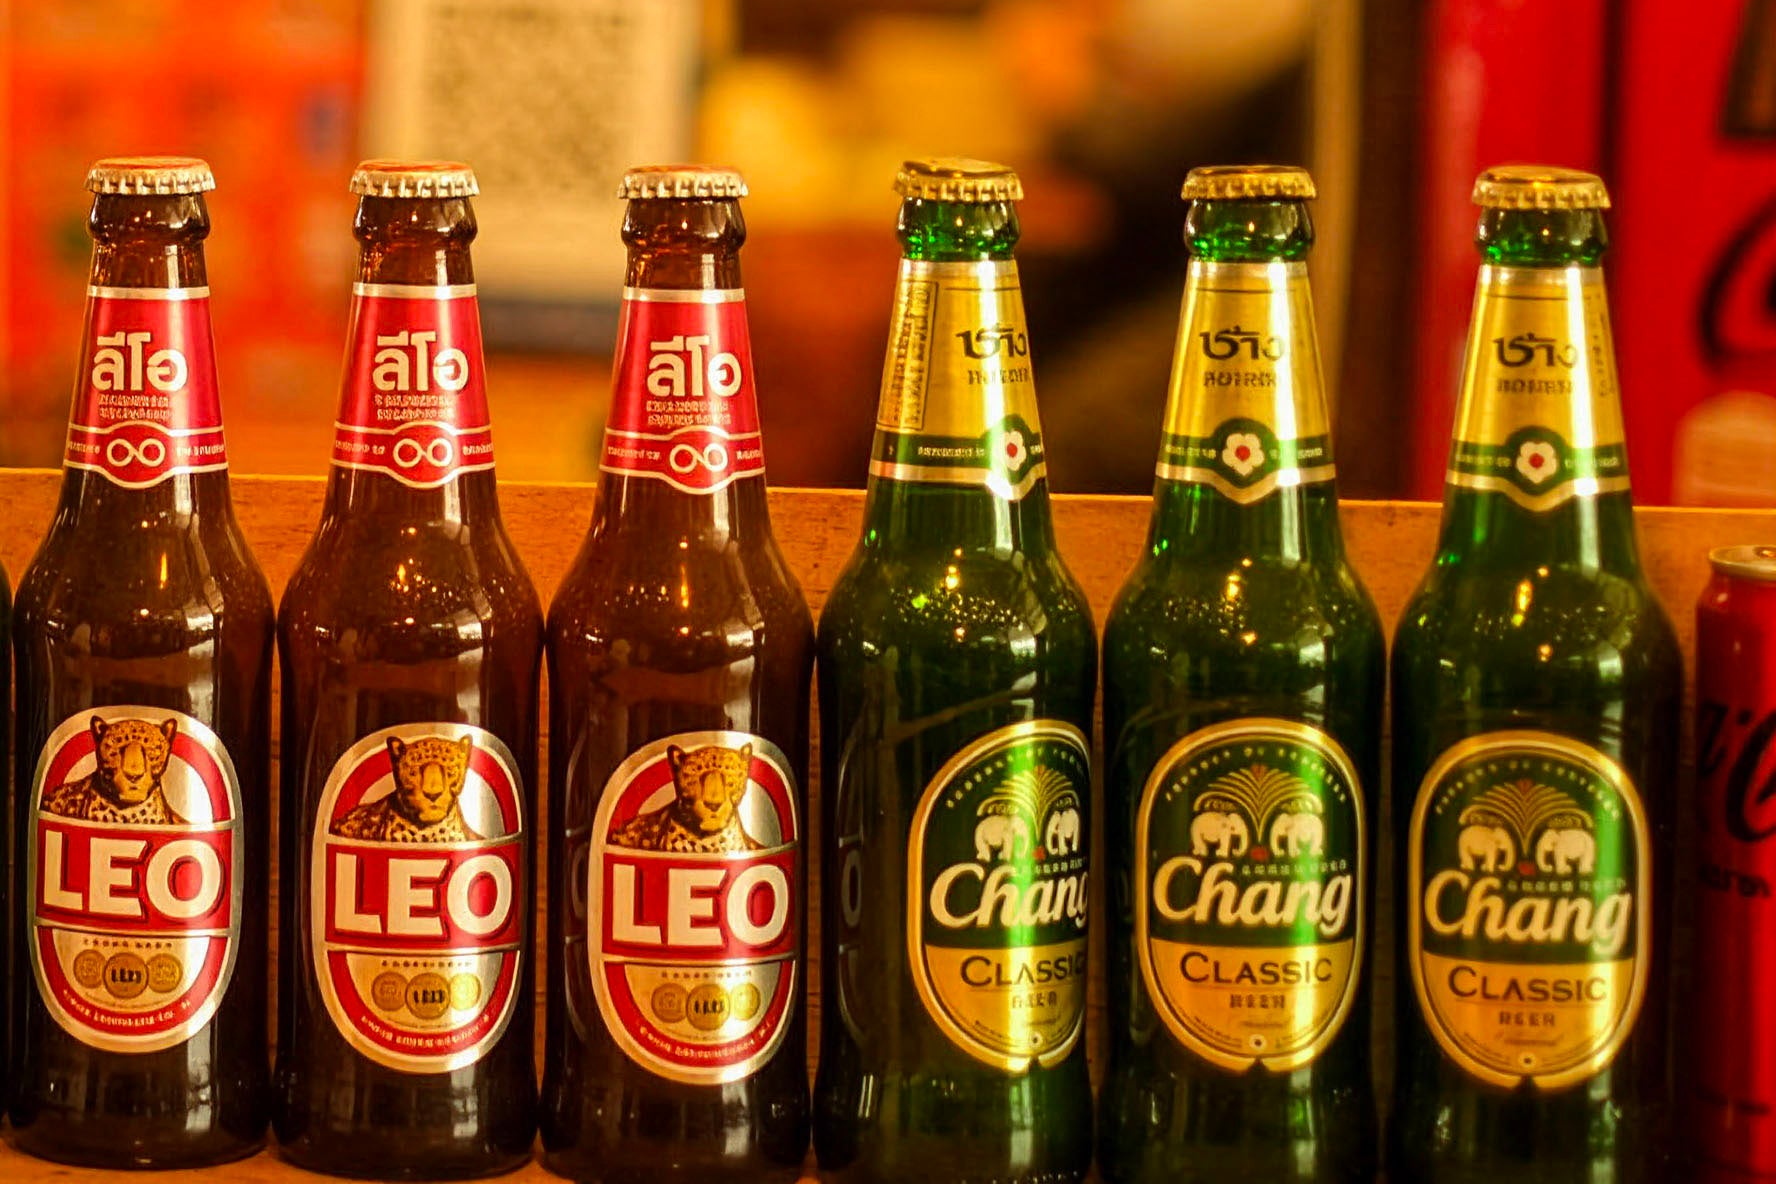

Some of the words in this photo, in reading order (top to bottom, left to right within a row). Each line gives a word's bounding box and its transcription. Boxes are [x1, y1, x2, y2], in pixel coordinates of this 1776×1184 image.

[91, 331, 188, 392] ลีโอ
[372, 331, 469, 392] ลีโอ
[647, 335, 742, 397] ลีโอ
[43, 829, 222, 919] LEO
[334, 852, 513, 936] LEO
[611, 863, 789, 947] LEO
[1153, 856, 1352, 938] Chang
[1424, 869, 1633, 955] Chang
[1179, 950, 1333, 985] CLASSIC
[1447, 966, 1608, 1002] CLASSIC
